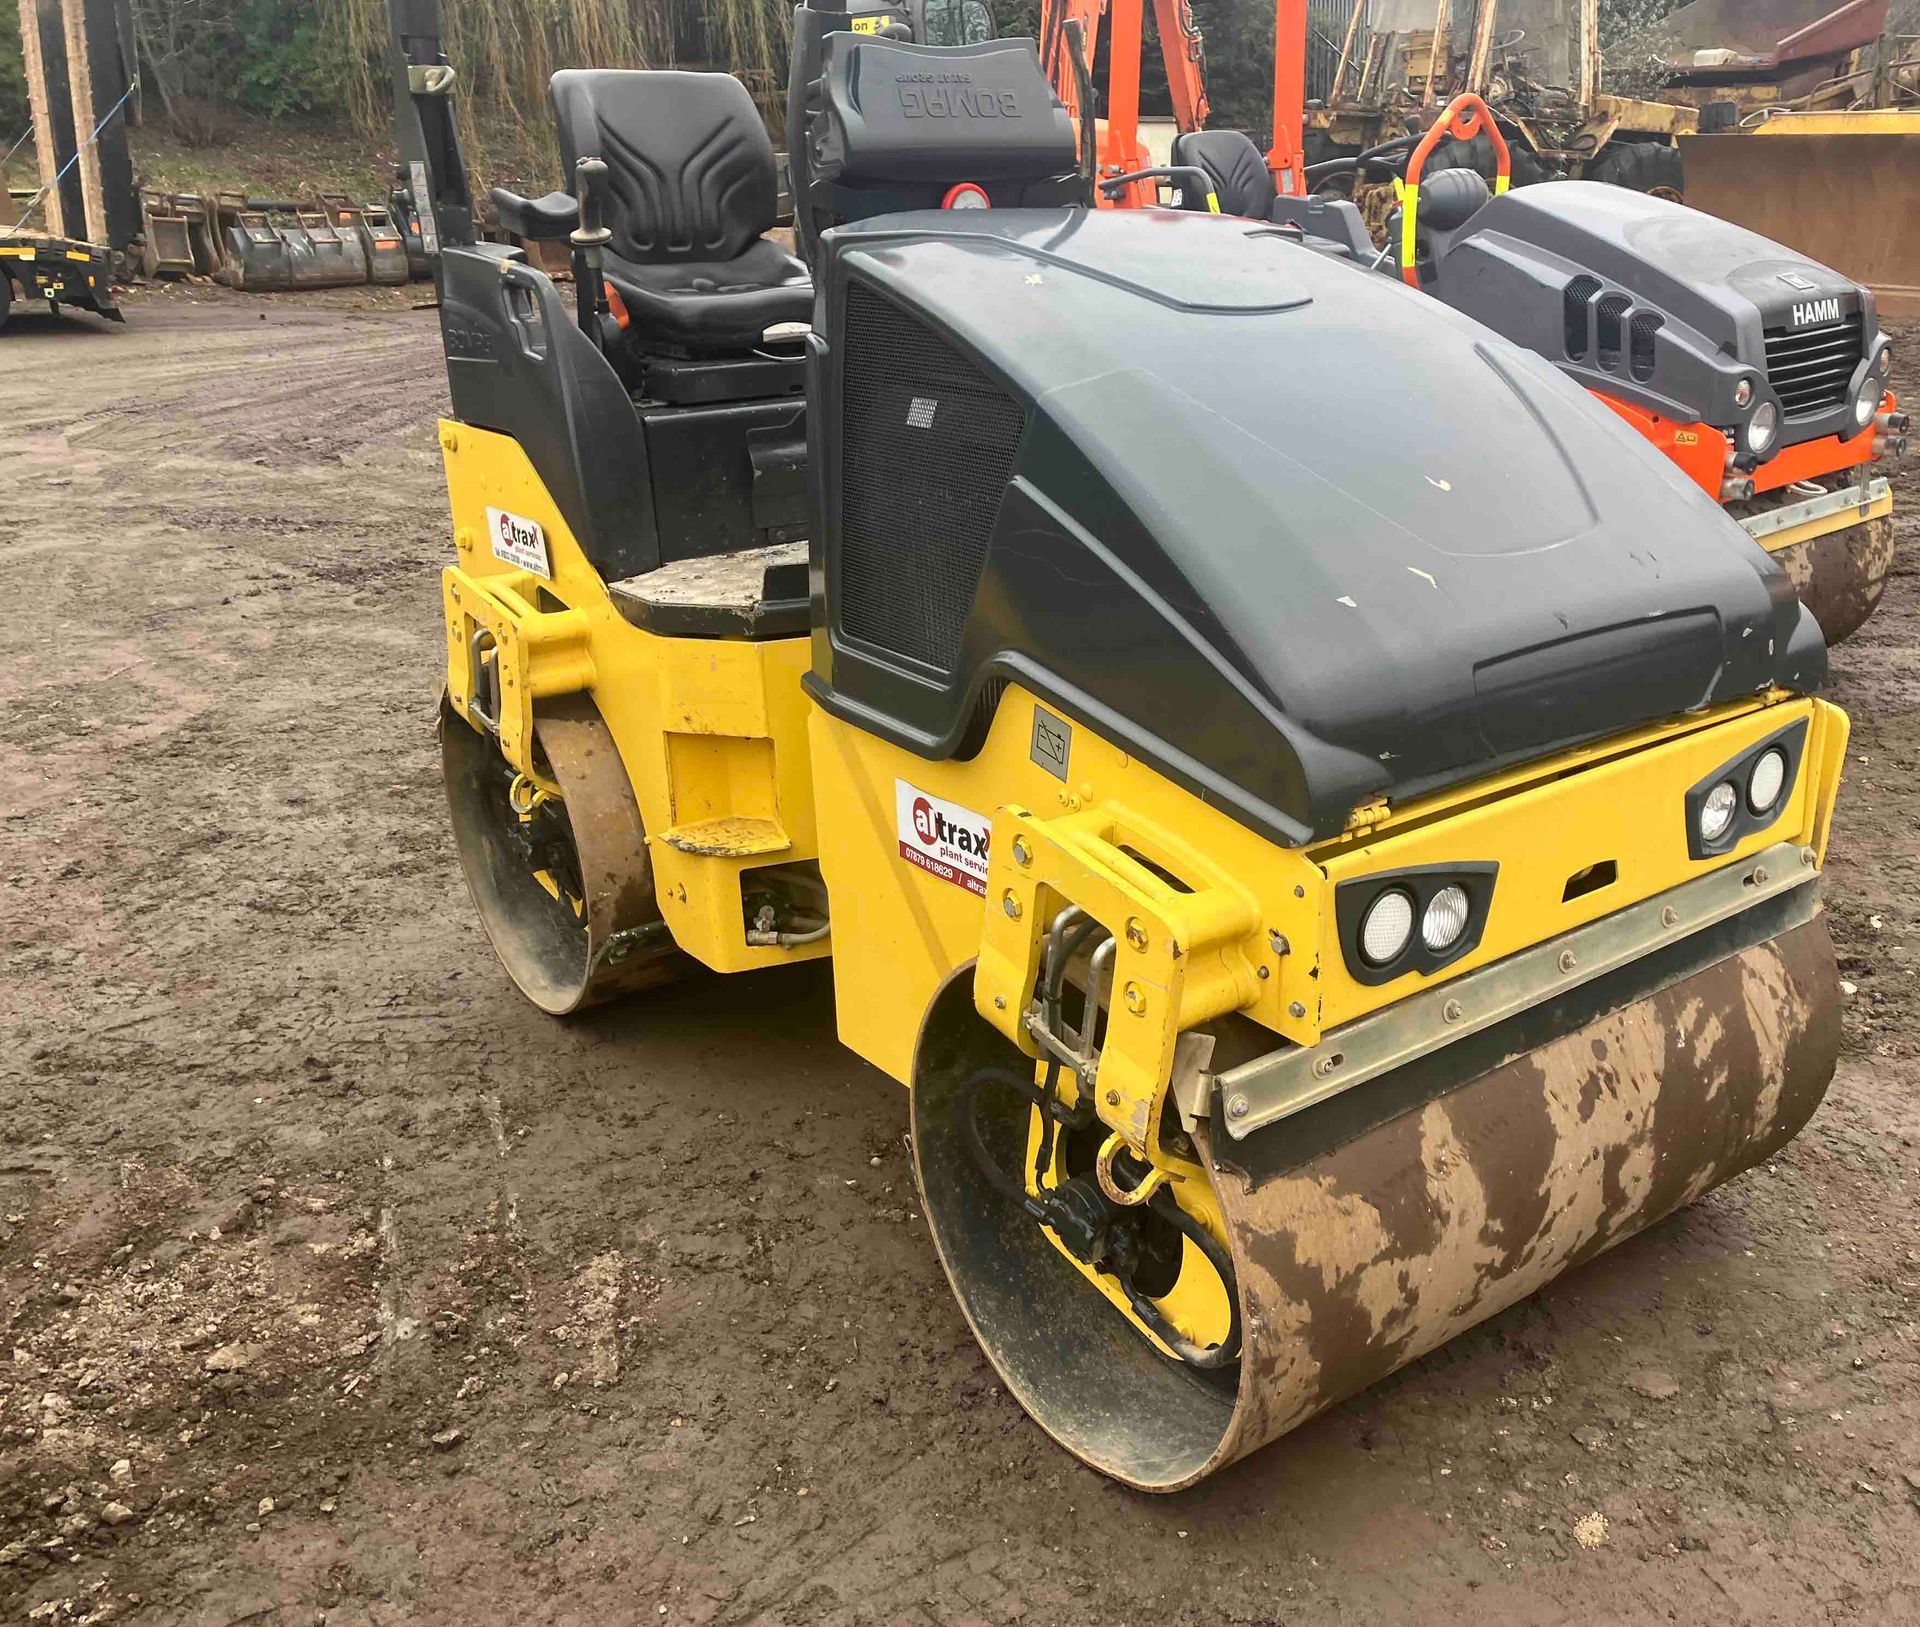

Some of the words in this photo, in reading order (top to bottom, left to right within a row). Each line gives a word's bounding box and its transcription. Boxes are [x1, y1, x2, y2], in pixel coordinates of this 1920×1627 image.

[897, 87, 1023, 119] BOMAG
[1793, 298, 1839, 325] HAMM
[905, 847, 925, 866] 07879
[940, 845, 963, 864] plant
